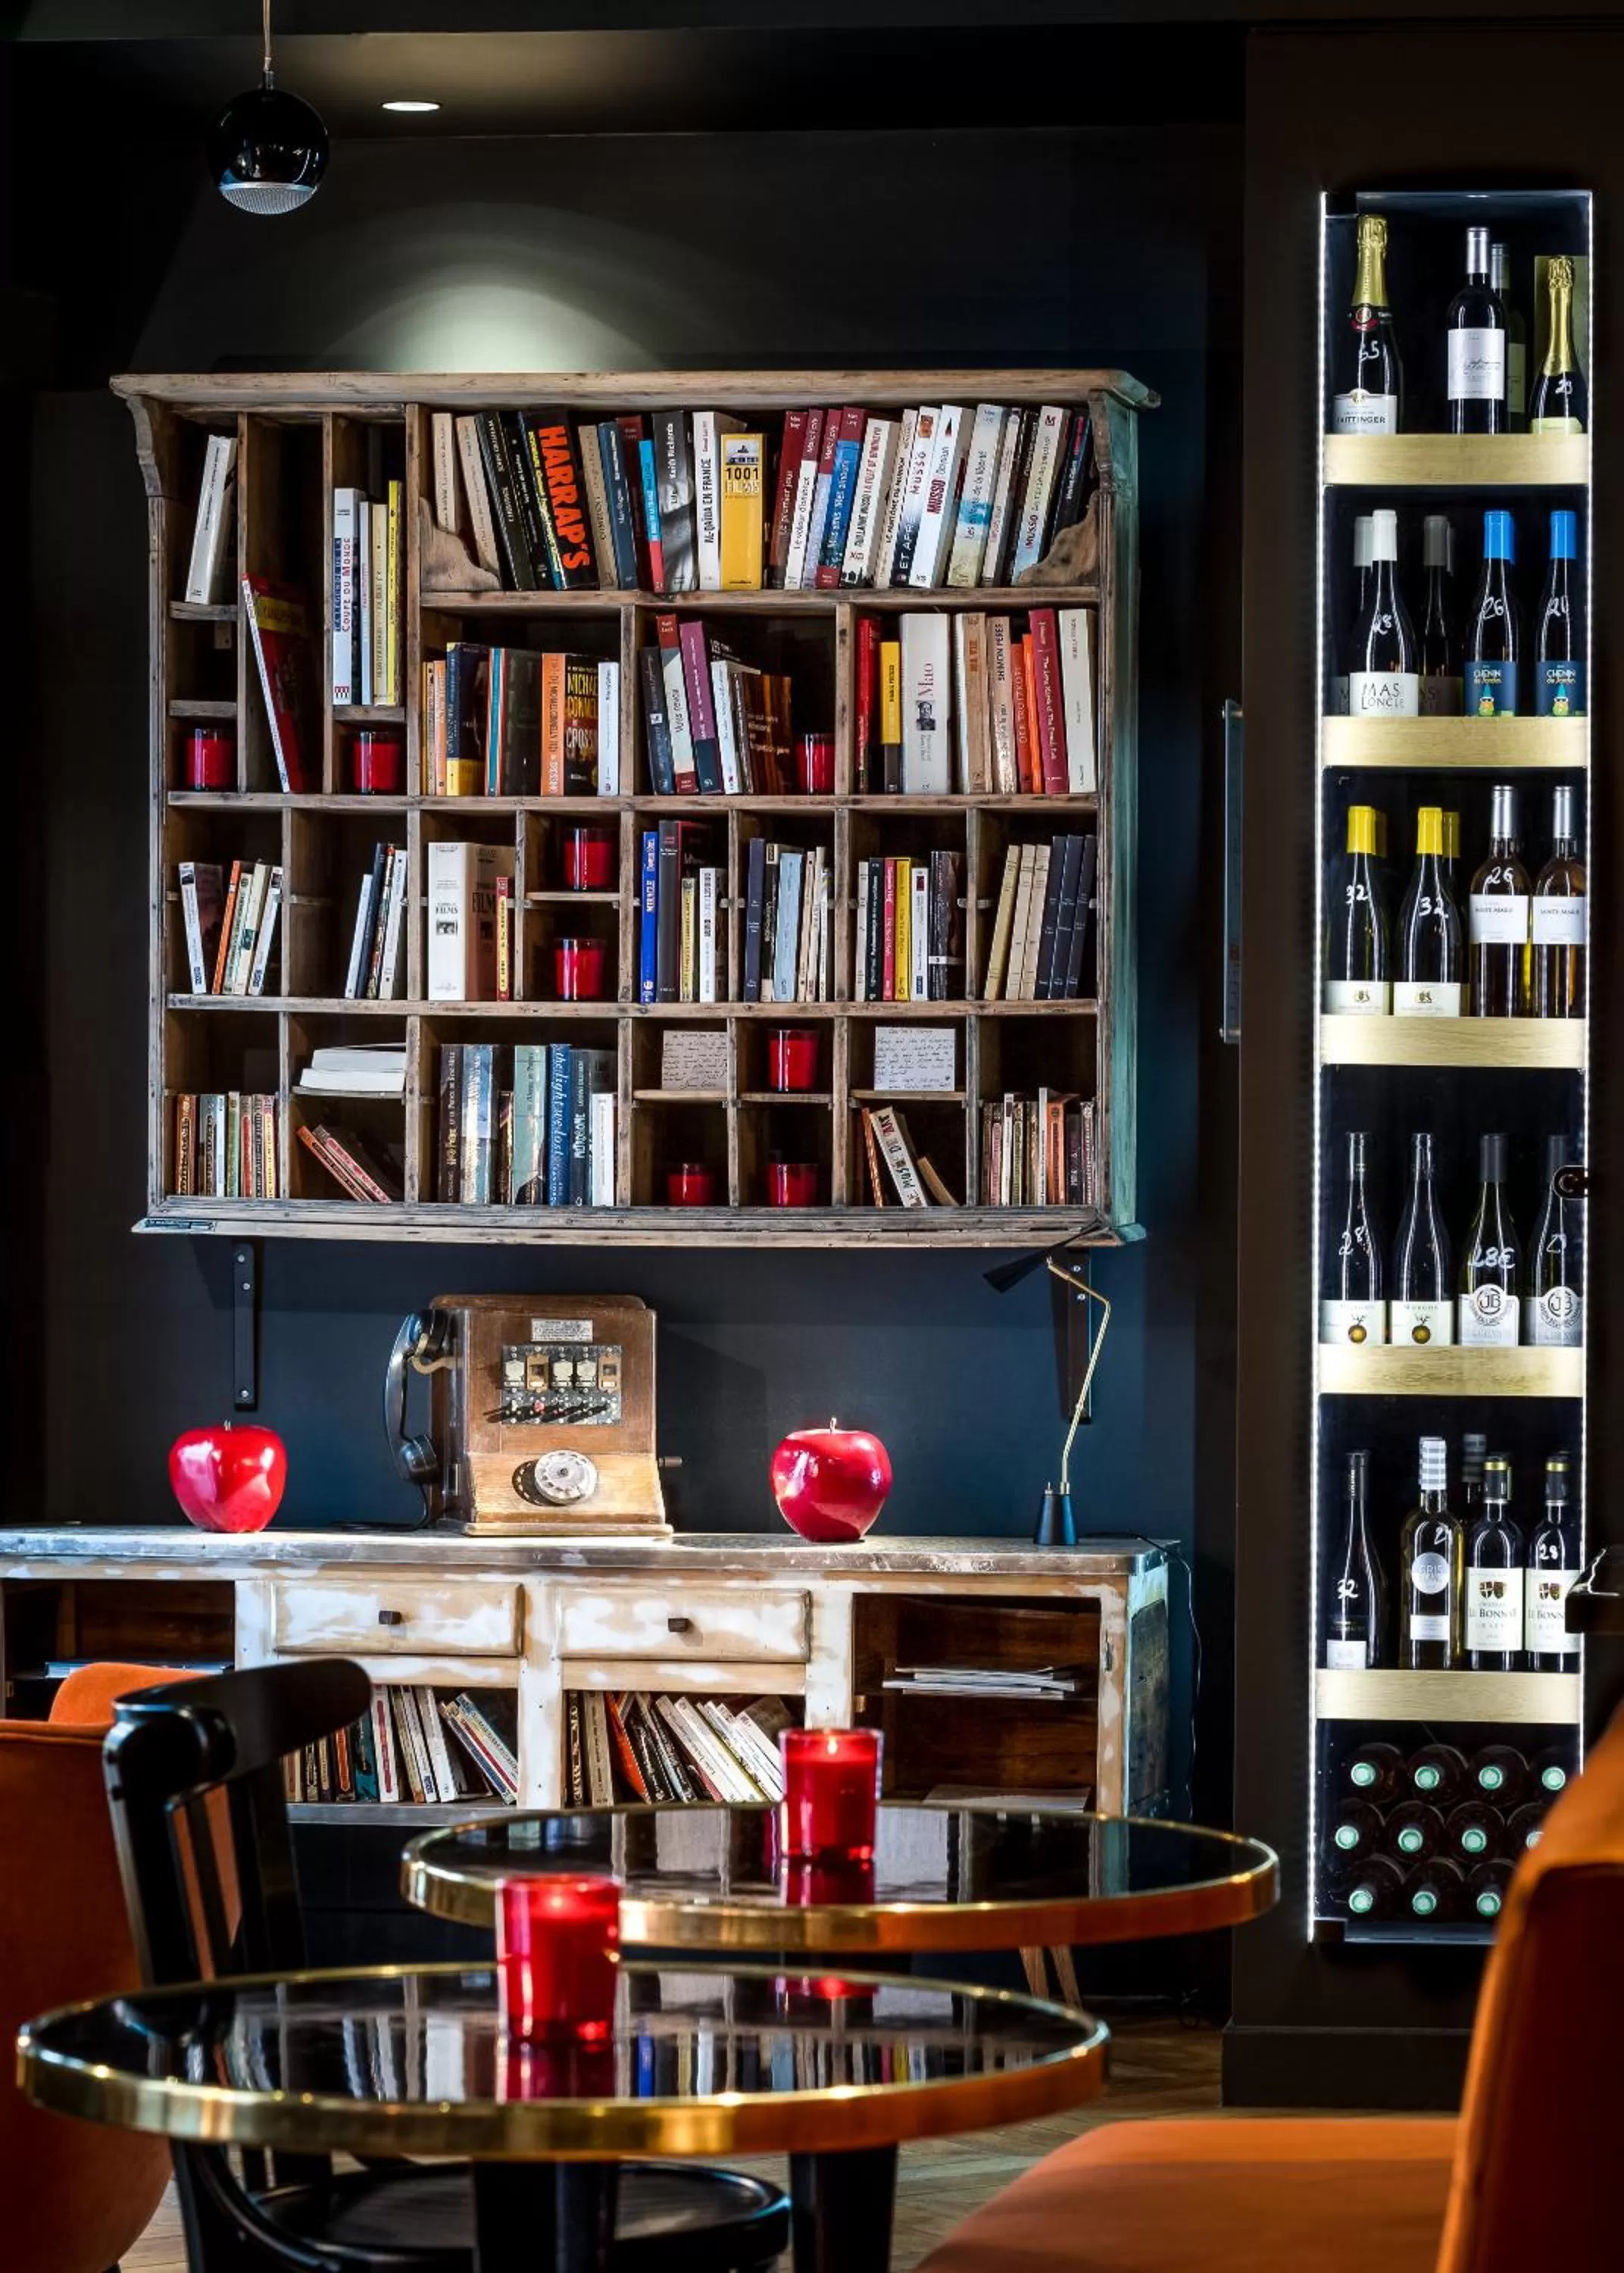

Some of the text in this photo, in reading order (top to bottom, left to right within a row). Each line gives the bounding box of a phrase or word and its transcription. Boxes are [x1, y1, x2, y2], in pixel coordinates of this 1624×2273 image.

[666, 423, 676, 478] Keith Richards
[700, 457, 712, 490] FRANCE
[726, 467, 758, 480] 1001
[783, 470, 795, 488] jour
[908, 449, 928, 496] MUSSO
[536, 424, 592, 571] HARRAP'S
[702, 492, 713, 504] EN
[779, 489, 795, 522] premier
[925, 477, 946, 515] MUSSO
[1023, 513, 1039, 549] MUSSO
[899, 552, 910, 569] ET
[342, 537, 350, 631] COUPE DU MONDE
[995, 623, 1004, 680] SHIMON PERES
[567, 672, 598, 696] MICHAE
[917, 662, 934, 696] Mao
[1363, 683, 1401, 698] MAS
[436, 905, 458, 915] FILMS
[551, 1052, 567, 1157] the light we lost
[1539, 1545, 1559, 1561] 28
